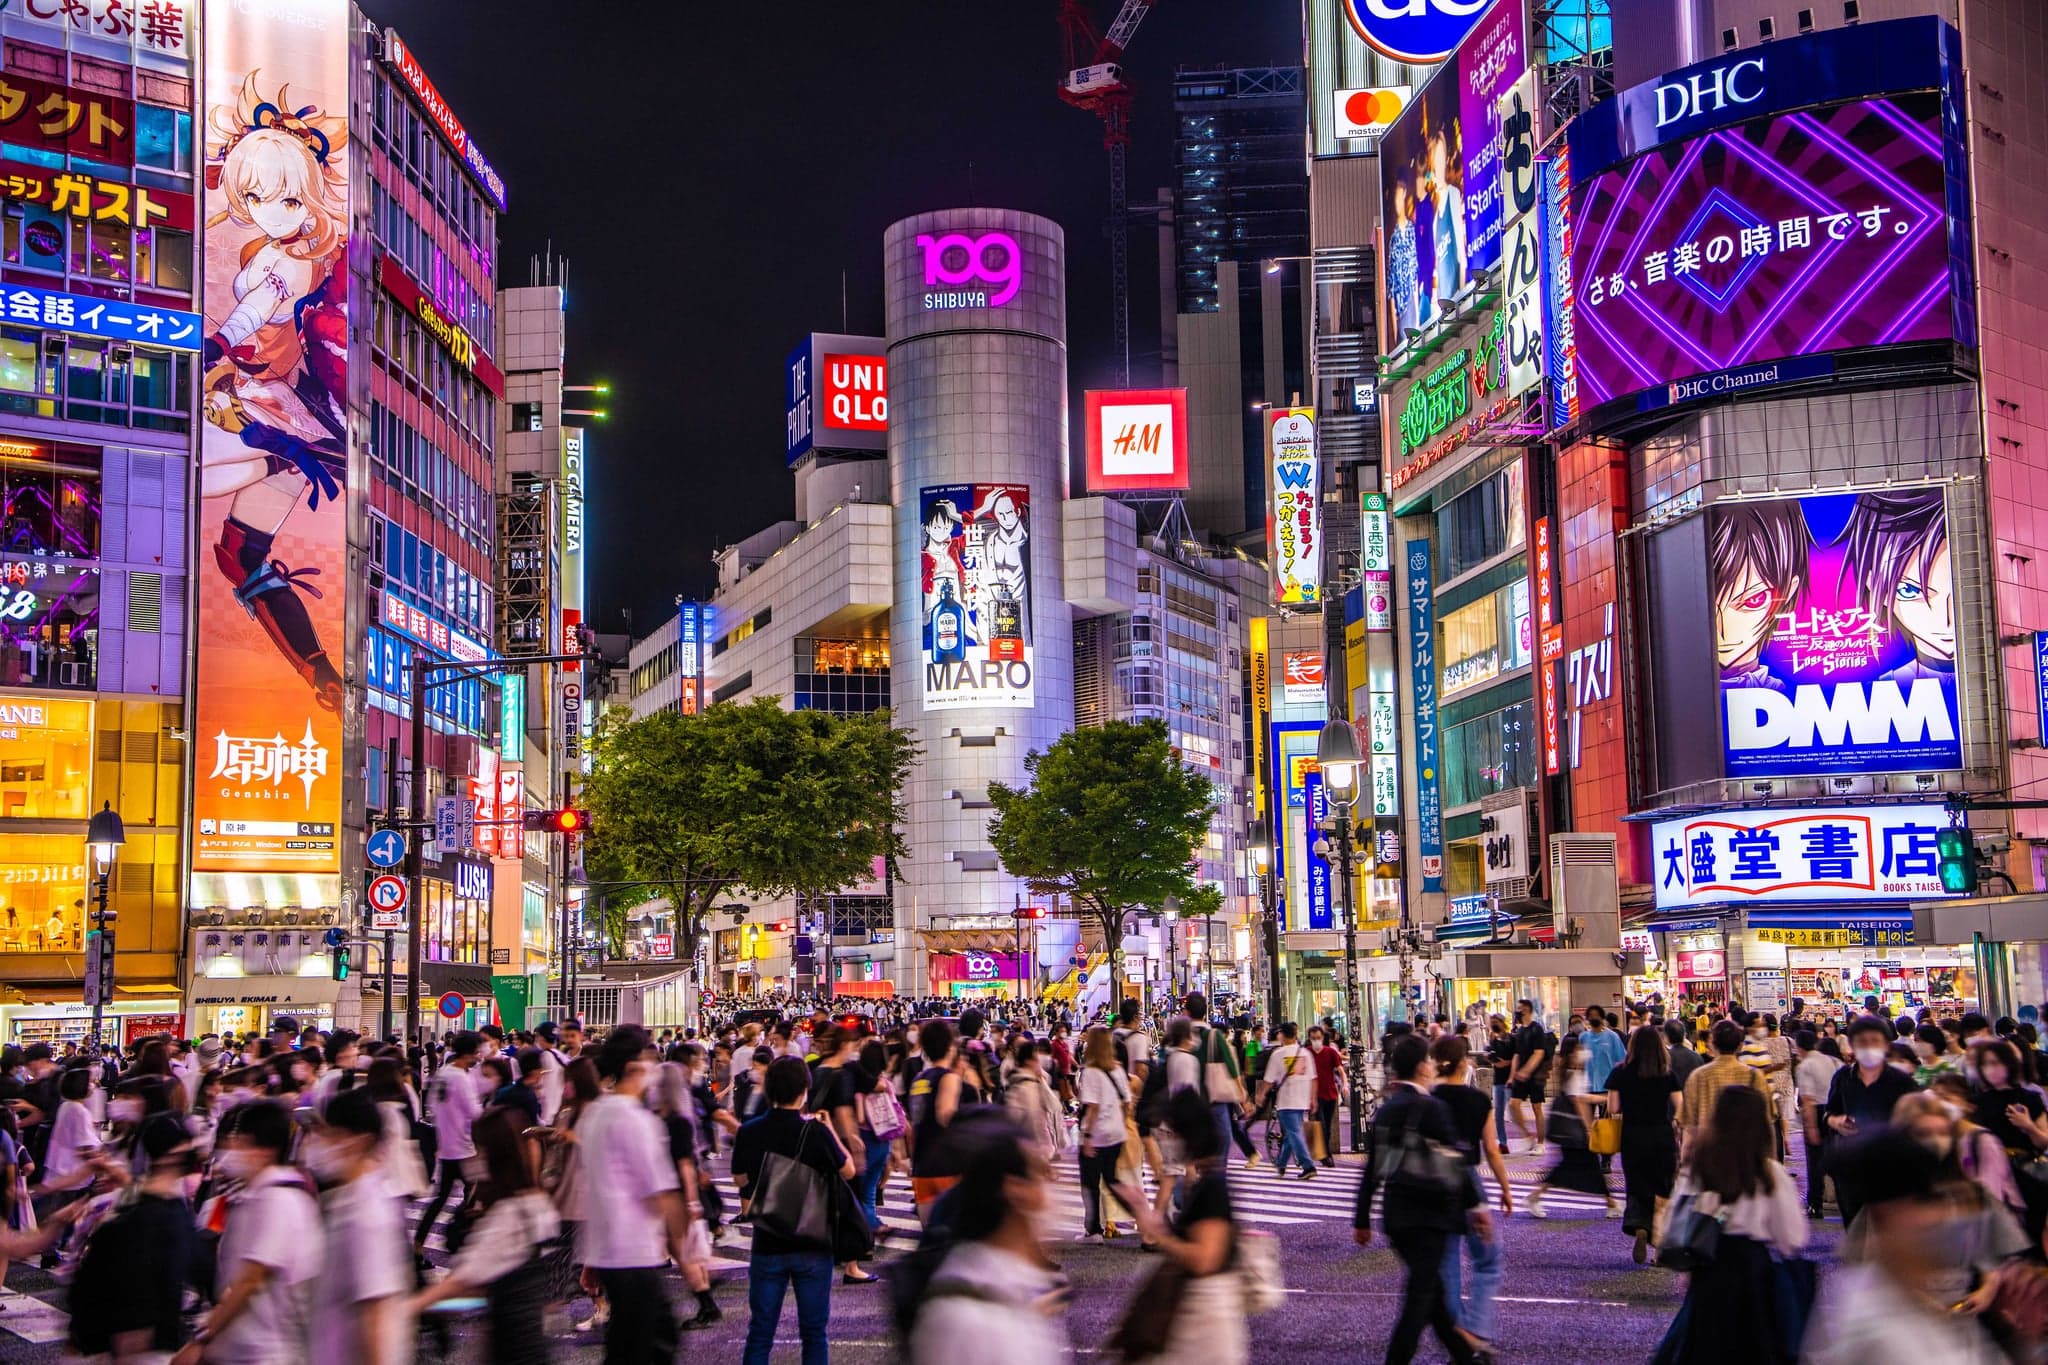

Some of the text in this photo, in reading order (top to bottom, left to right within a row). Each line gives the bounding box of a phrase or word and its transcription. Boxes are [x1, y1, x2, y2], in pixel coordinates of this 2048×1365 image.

[1654, 57, 1764, 128] DHC
[1468, 160, 1482, 181] THE
[51, 173, 168, 229] ガスト
[1502, 90, 1542, 376] もんじゃ
[917, 232, 1021, 307] 109
[1589, 204, 1909, 307] さあ、音楽の時間です。
[924, 292, 986, 309] SHIBUYA
[80, 303, 195, 341] イーオン
[450, 324, 477, 372] ガスト
[792, 355, 806, 403] THE
[832, 363, 884, 391] UNI
[1676, 365, 1779, 400] DHC Channel
[787, 395, 811, 451] PRIME
[832, 393, 888, 424] QLO
[1113, 423, 1162, 456] H&M
[566, 438, 581, 552] BIC CAMERA
[1277, 491, 1297, 574] つかえる！
[565, 624, 579, 654] 免税
[1772, 606, 1888, 637] コードギアス
[926, 660, 1032, 693] MARO
[1256, 652, 1265, 691] KiYoshi
[1411, 577, 1435, 762] サマーフルーツギフト
[1792, 650, 1868, 676] Lost Stories
[563, 683, 580, 712] OS
[1725, 677, 1956, 751] DMM
[1373, 710, 1383, 740] パーラー
[1383, 704, 1392, 736] フルーツ
[208, 716, 329, 813] 原神
[220, 787, 291, 801] Genshin
[1376, 771, 1385, 802] フルーツ
[1312, 783, 1323, 826] MIZUH
[225, 823, 247, 834] 原神
[444, 800, 456, 848] 渋谷駅前
[1662, 822, 1938, 890] 大盛堂書店
[457, 862, 489, 900] LUSH
[1312, 866, 1325, 917] みずほ銀行
[1883, 882, 1912, 892] BOOKS
[1839, 921, 1902, 929] TAISEIDO
[966, 957, 996, 979] 109
[194, 996, 236, 1005] SHIBUYA
[240, 995, 278, 1004] EKIMAE
[272, 1007, 296, 1016] SHIBUYA
[296, 1007, 317, 1016] EKIMAE
